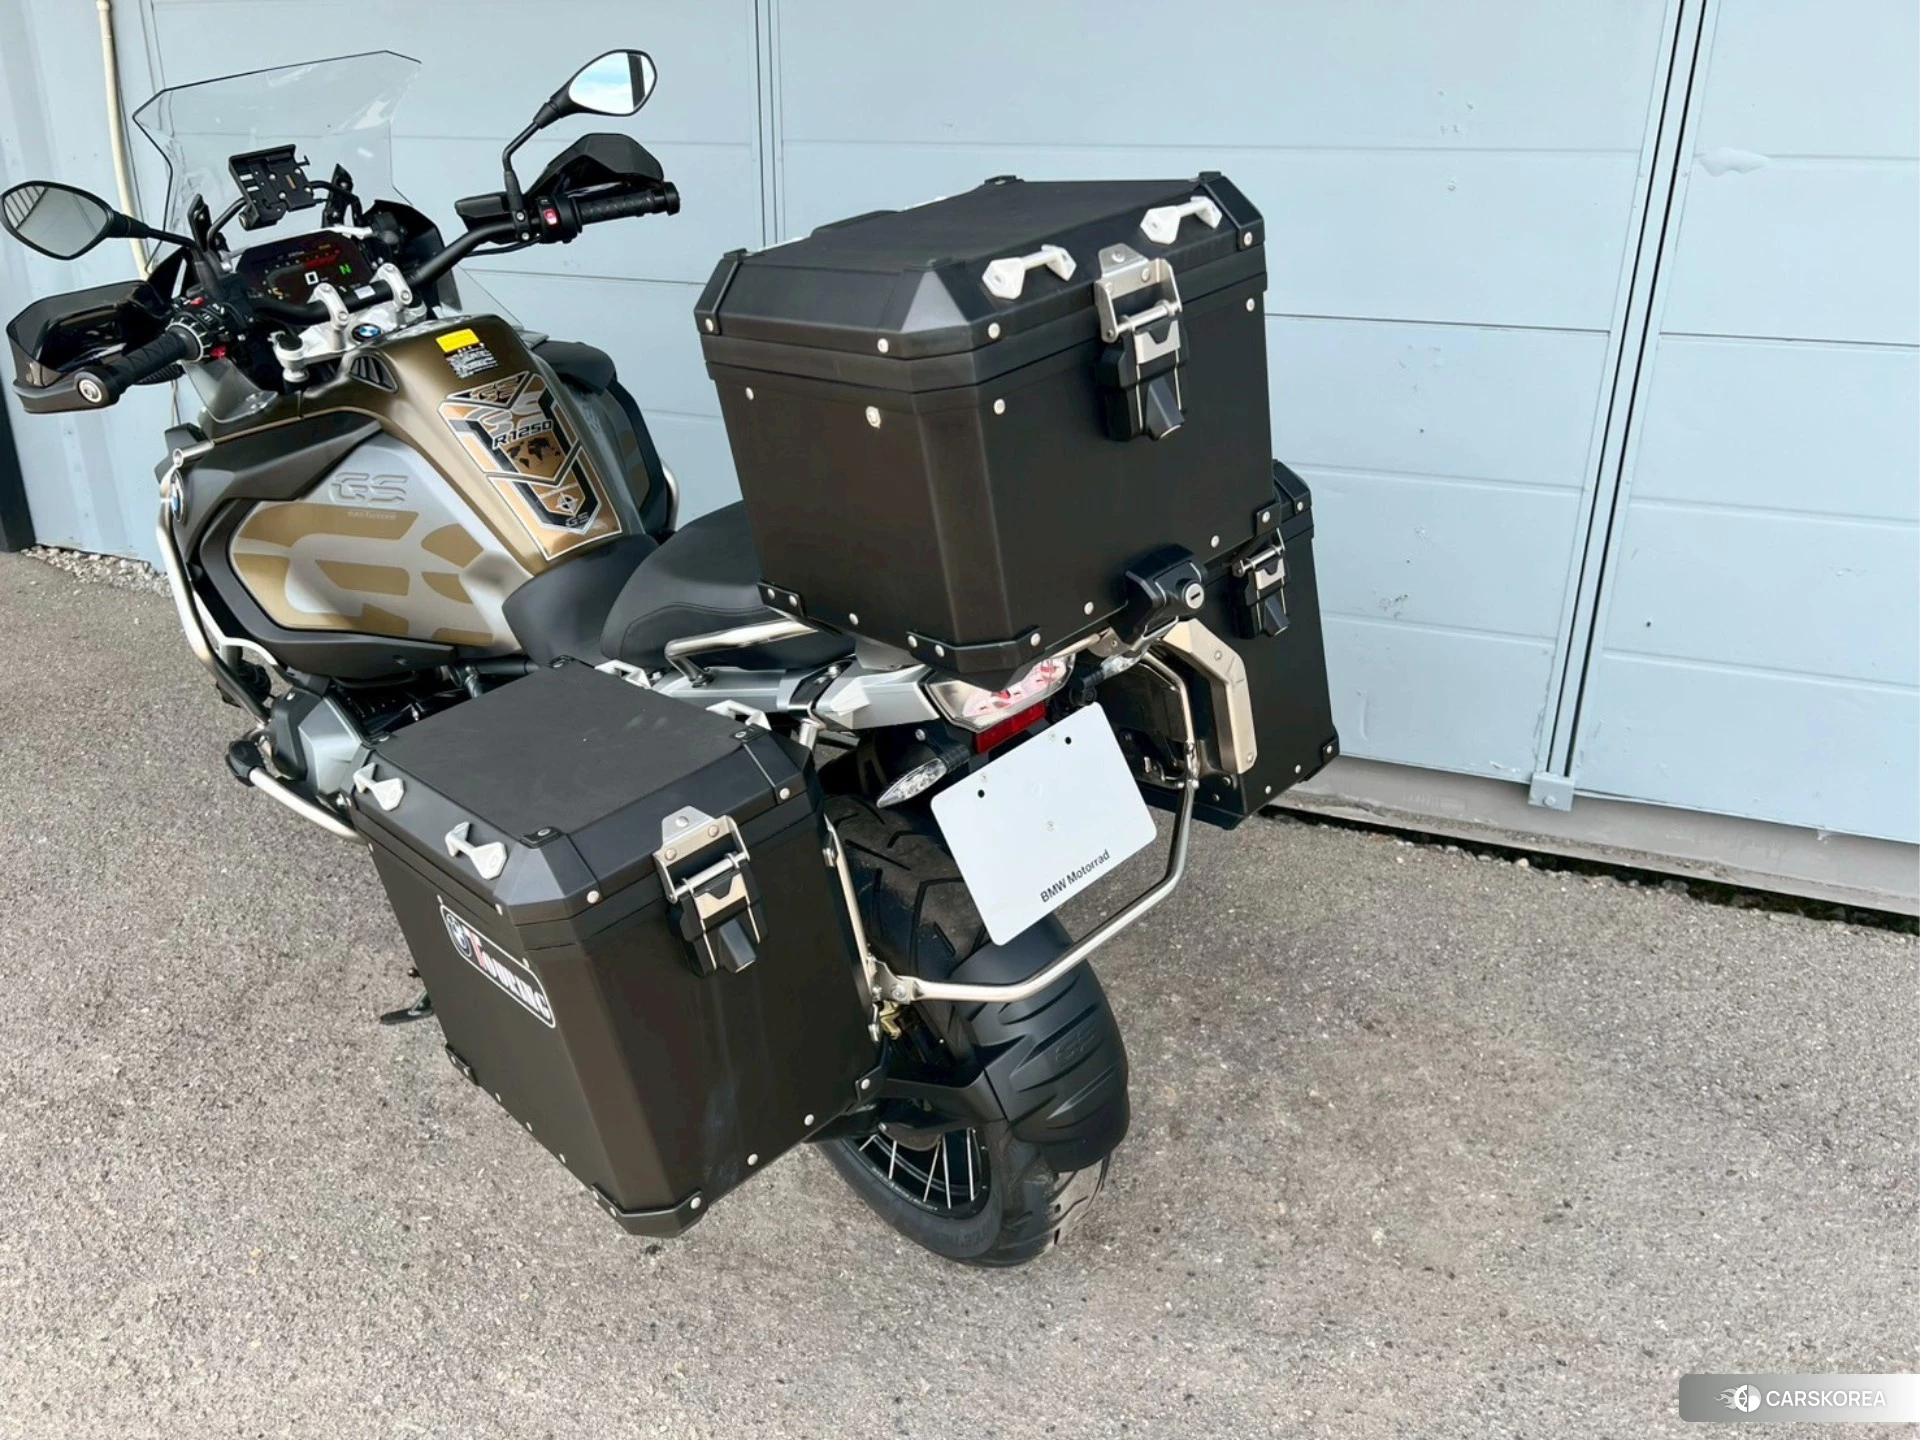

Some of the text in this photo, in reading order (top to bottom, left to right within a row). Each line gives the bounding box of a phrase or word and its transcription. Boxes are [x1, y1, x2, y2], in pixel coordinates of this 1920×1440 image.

[329, 472, 408, 506] GS
[565, 511, 590, 527] GS
[1040, 848, 1111, 903] BMW Motorrad
